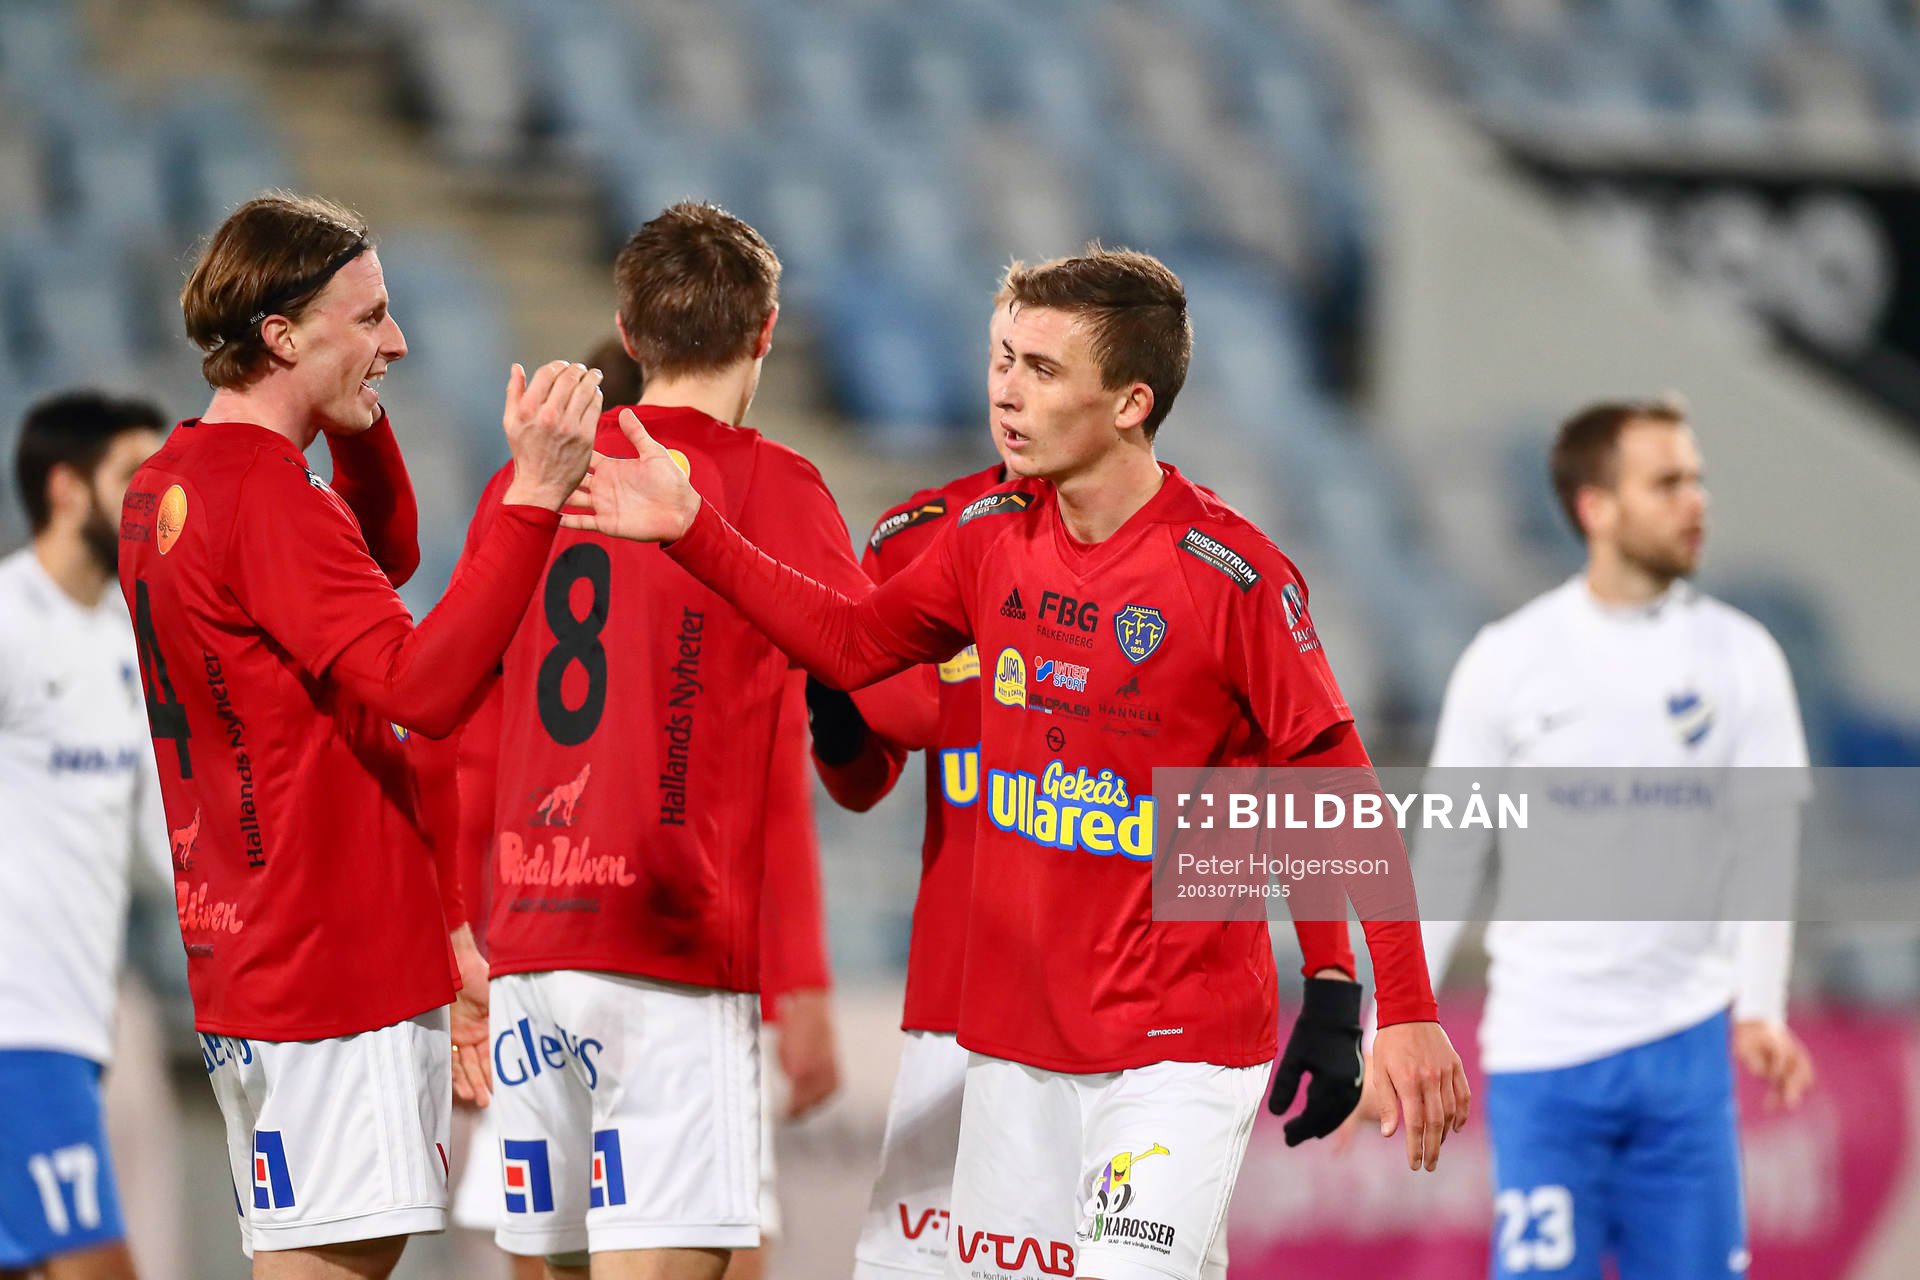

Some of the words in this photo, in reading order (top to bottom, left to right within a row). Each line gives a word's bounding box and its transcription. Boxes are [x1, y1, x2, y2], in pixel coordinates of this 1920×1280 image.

[250, 310, 267, 325] NIKE
[973, 495, 998, 510] BYGG
[1186, 529, 1257, 583] HUSCENTRUM
[1000, 606, 1026, 621] adidas
[1036, 624, 1094, 649] FALKENBERG
[1038, 590, 1099, 633] FBG
[537, 542, 611, 747] 8
[668, 606, 705, 710] Nyheter
[136, 579, 192, 779] 4
[1053, 660, 1089, 681] INTER
[1053, 673, 1086, 693] SPORT
[202, 649, 246, 748] Nyheter
[1098, 703, 1161, 721] HANNELL
[659, 712, 693, 826] Hallands
[1042, 761, 1129, 808] Gekås
[236, 752, 267, 868] Hallands
[991, 772, 1154, 857] Ullared
[28, 1143, 100, 1236] 17
[1104, 1217, 1176, 1247] KAROSSER
[1496, 1185, 1576, 1273] 23
